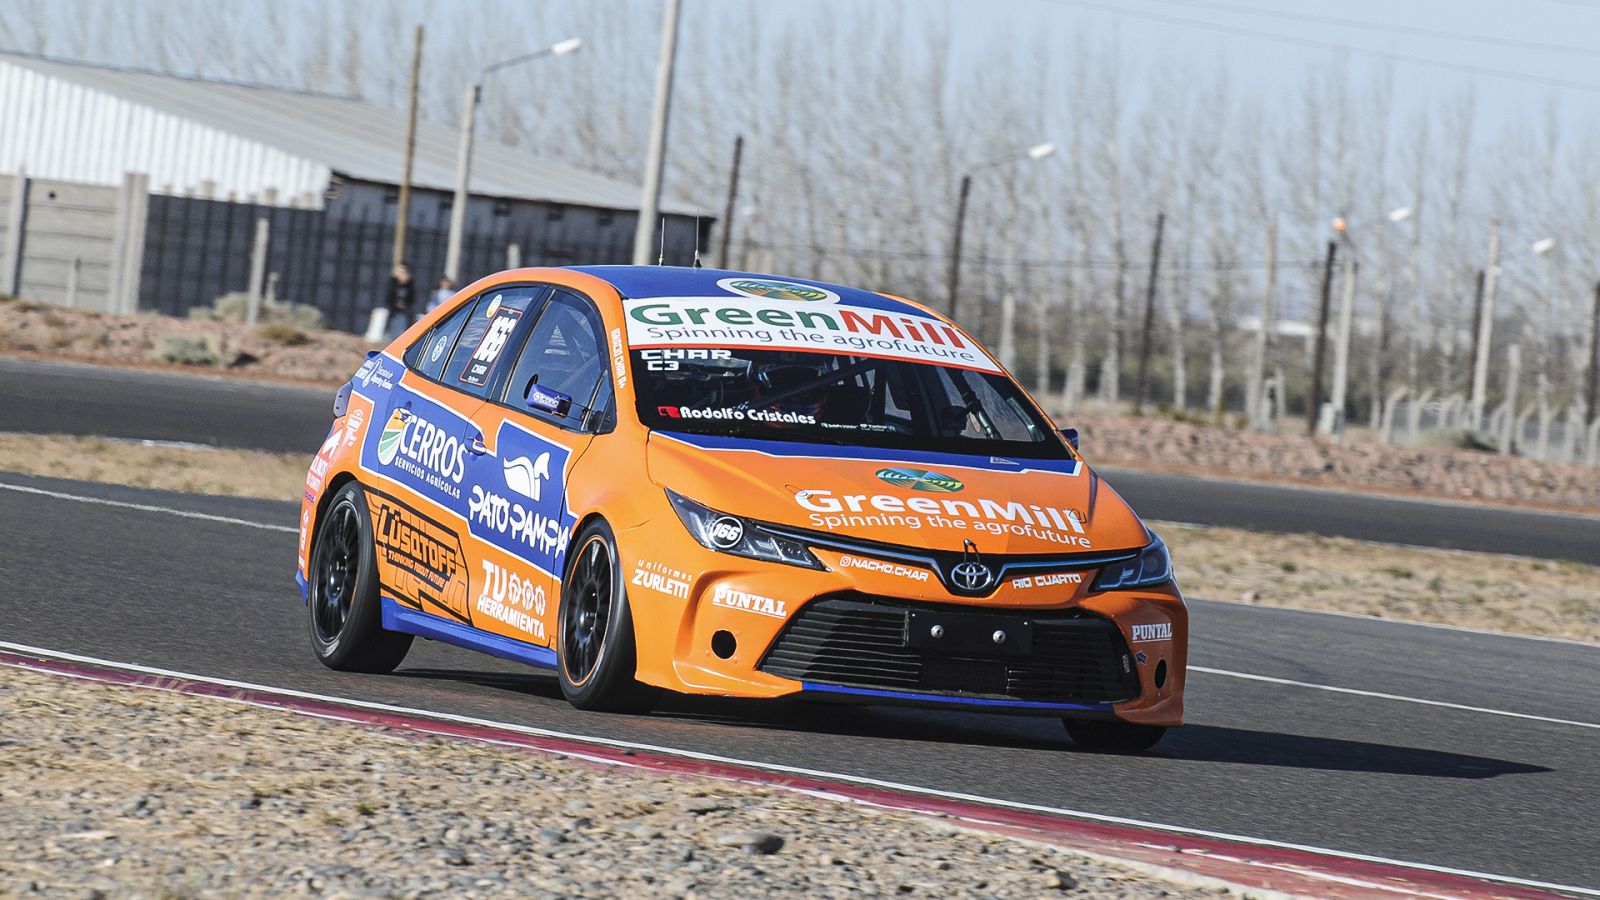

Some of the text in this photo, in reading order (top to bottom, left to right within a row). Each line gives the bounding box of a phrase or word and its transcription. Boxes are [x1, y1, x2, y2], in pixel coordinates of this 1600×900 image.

[630, 302, 966, 349] GreenMill
[640, 348, 732, 360] CHAR
[647, 326, 976, 362] Spinning the agrofuture
[646, 360, 680, 371] C3
[679, 406, 816, 425] Rodolfo Cristales
[399, 414, 469, 484] CERROS
[394, 455, 461, 500] SERVICIOS AGRÍCOLAS
[468, 484, 570, 559] PATO PAMPA
[794, 489, 1085, 534] GreenMill
[712, 522, 742, 541] 166
[808, 513, 1092, 549] Spinning the agrofuture
[482, 559, 507, 603] TU
[631, 568, 690, 600] ZURLETTI
[638, 558, 693, 582] uniformes
[1012, 573, 1082, 589] RIO CUARTO
[476, 593, 546, 641] HERRAMIENTA
[712, 583, 787, 618] PUNTAL
[1131, 622, 1173, 641] PUNTAL
